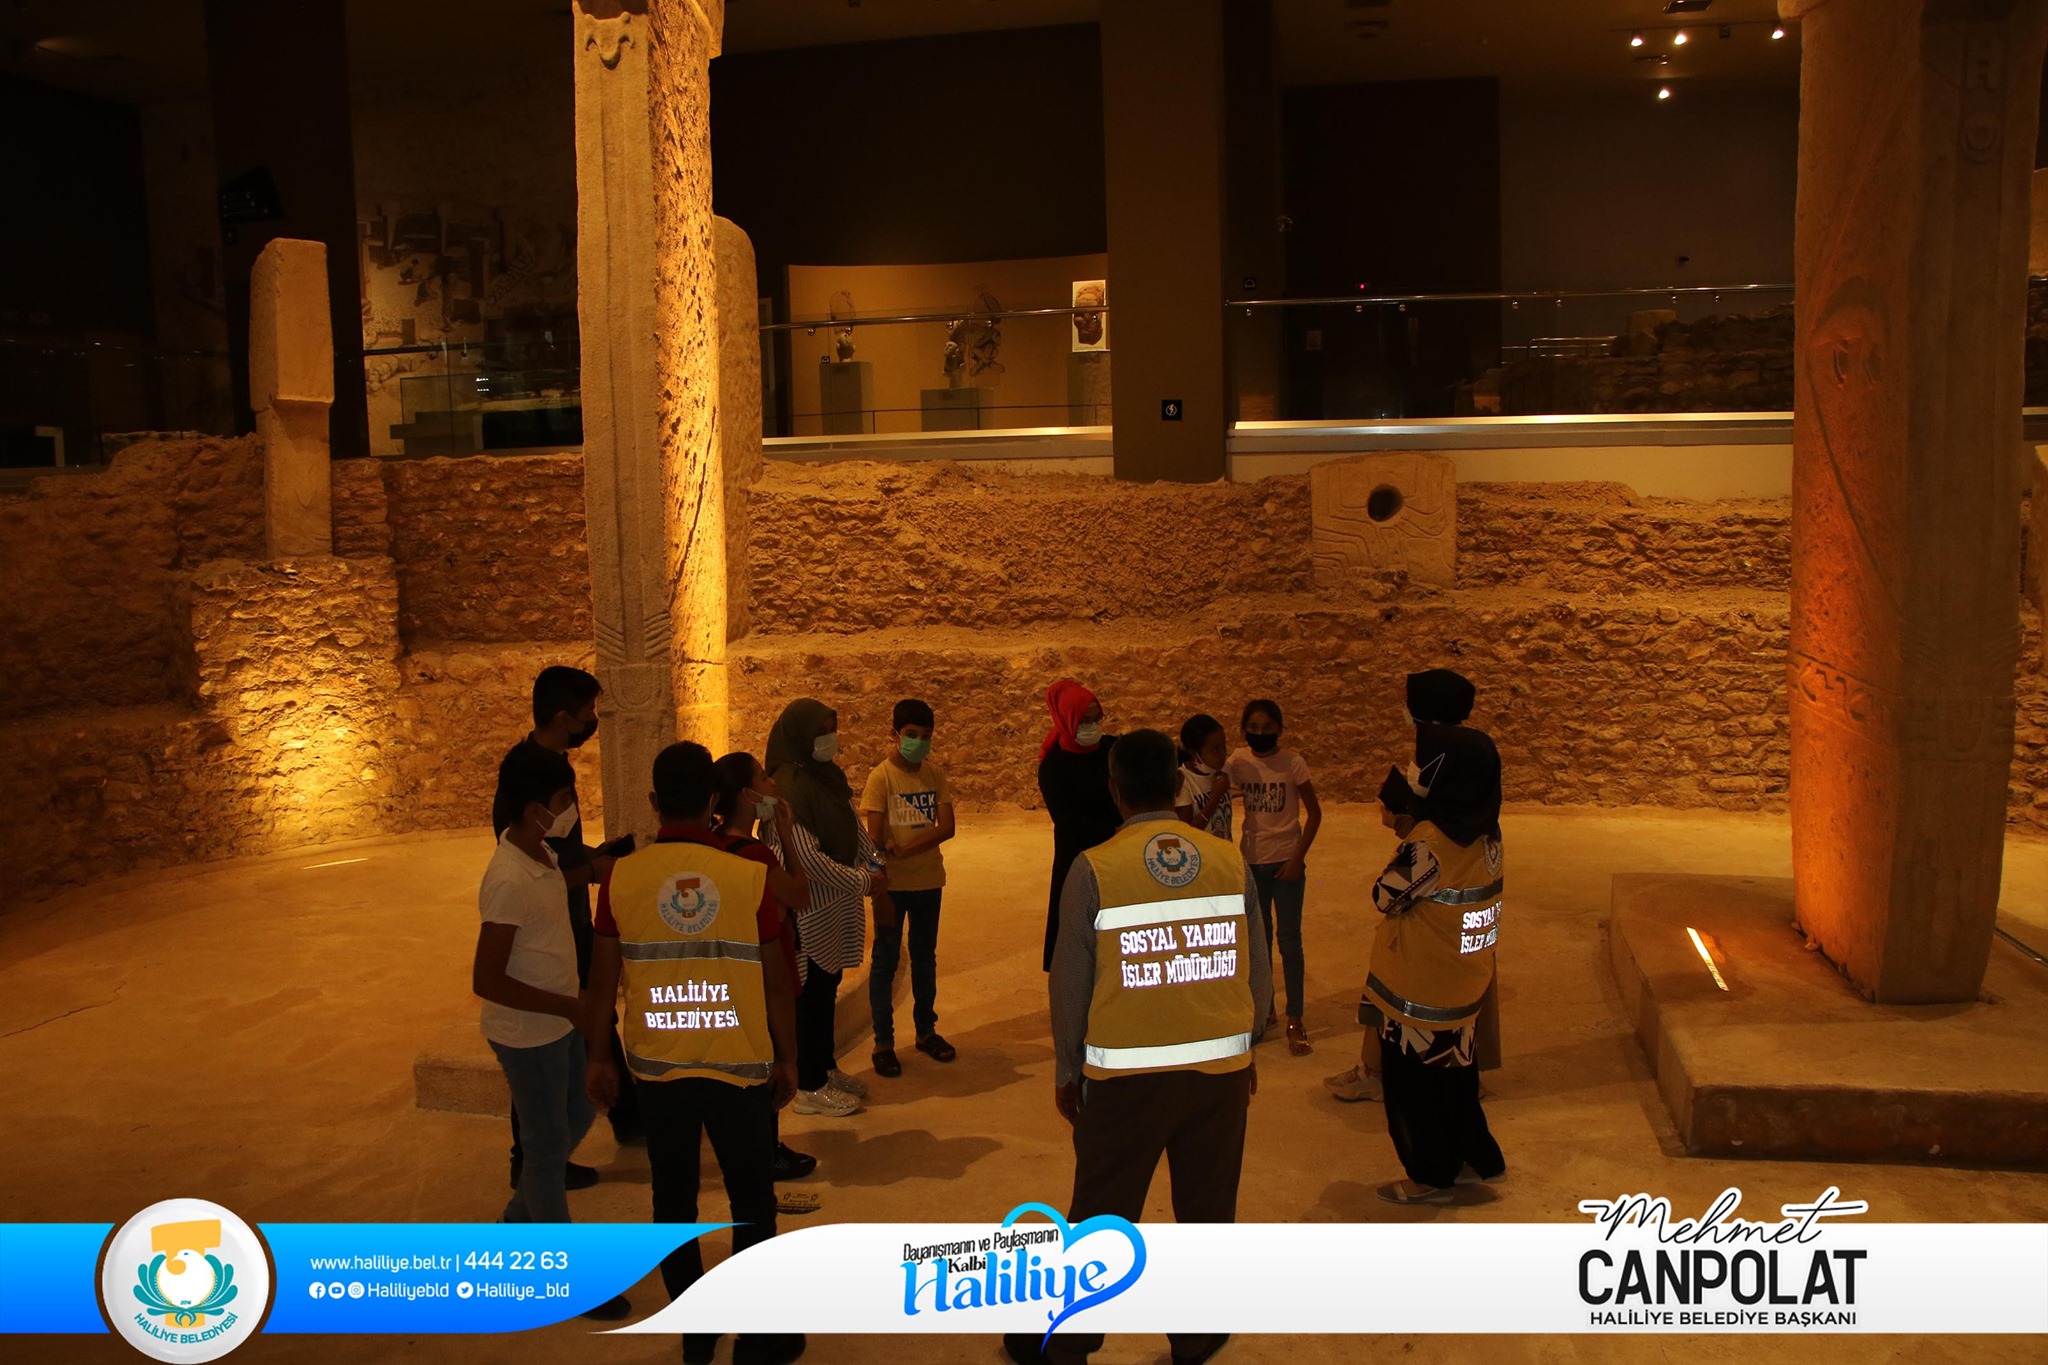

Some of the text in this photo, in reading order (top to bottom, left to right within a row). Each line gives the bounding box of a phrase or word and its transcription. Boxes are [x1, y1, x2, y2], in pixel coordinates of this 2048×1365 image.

[895, 793, 936, 809] BLACK
[1119, 920, 1237, 955] SOSYAL YARDIM
[1121, 950, 1237, 989] İŞLER MÜDÜRLÜĞÜ
[649, 979, 730, 1004] HALİLİYE
[644, 1005, 740, 1030] BELEDİYESİ
